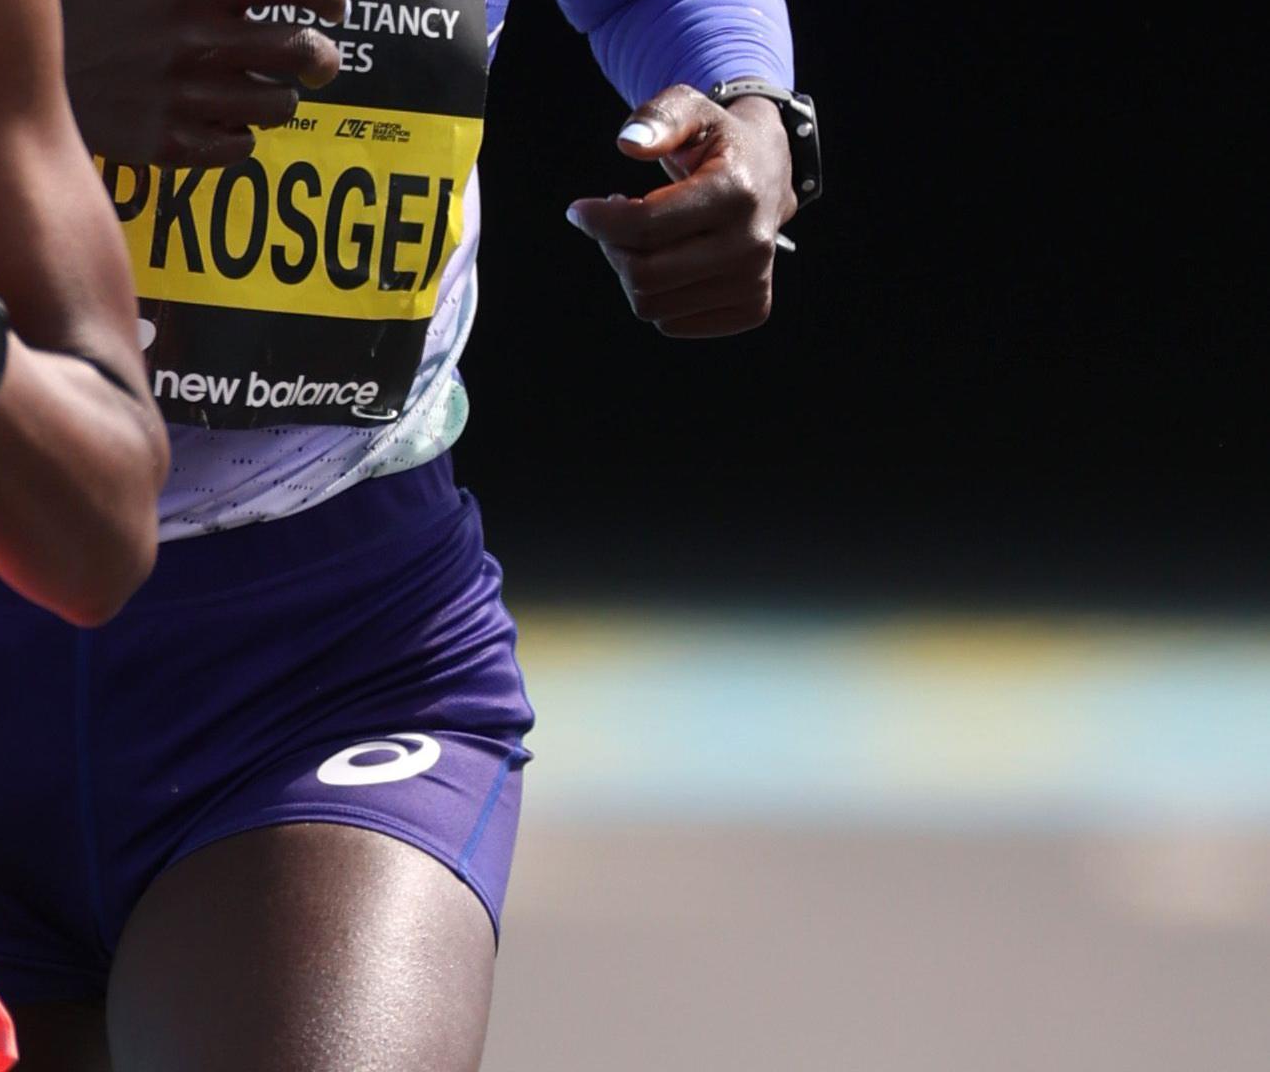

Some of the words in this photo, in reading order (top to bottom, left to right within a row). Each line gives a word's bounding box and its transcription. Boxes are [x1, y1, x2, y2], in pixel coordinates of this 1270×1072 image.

[102, 155, 454, 292] PKOSGEI
[154, 369, 241, 405] new
[246, 371, 379, 408] balance
